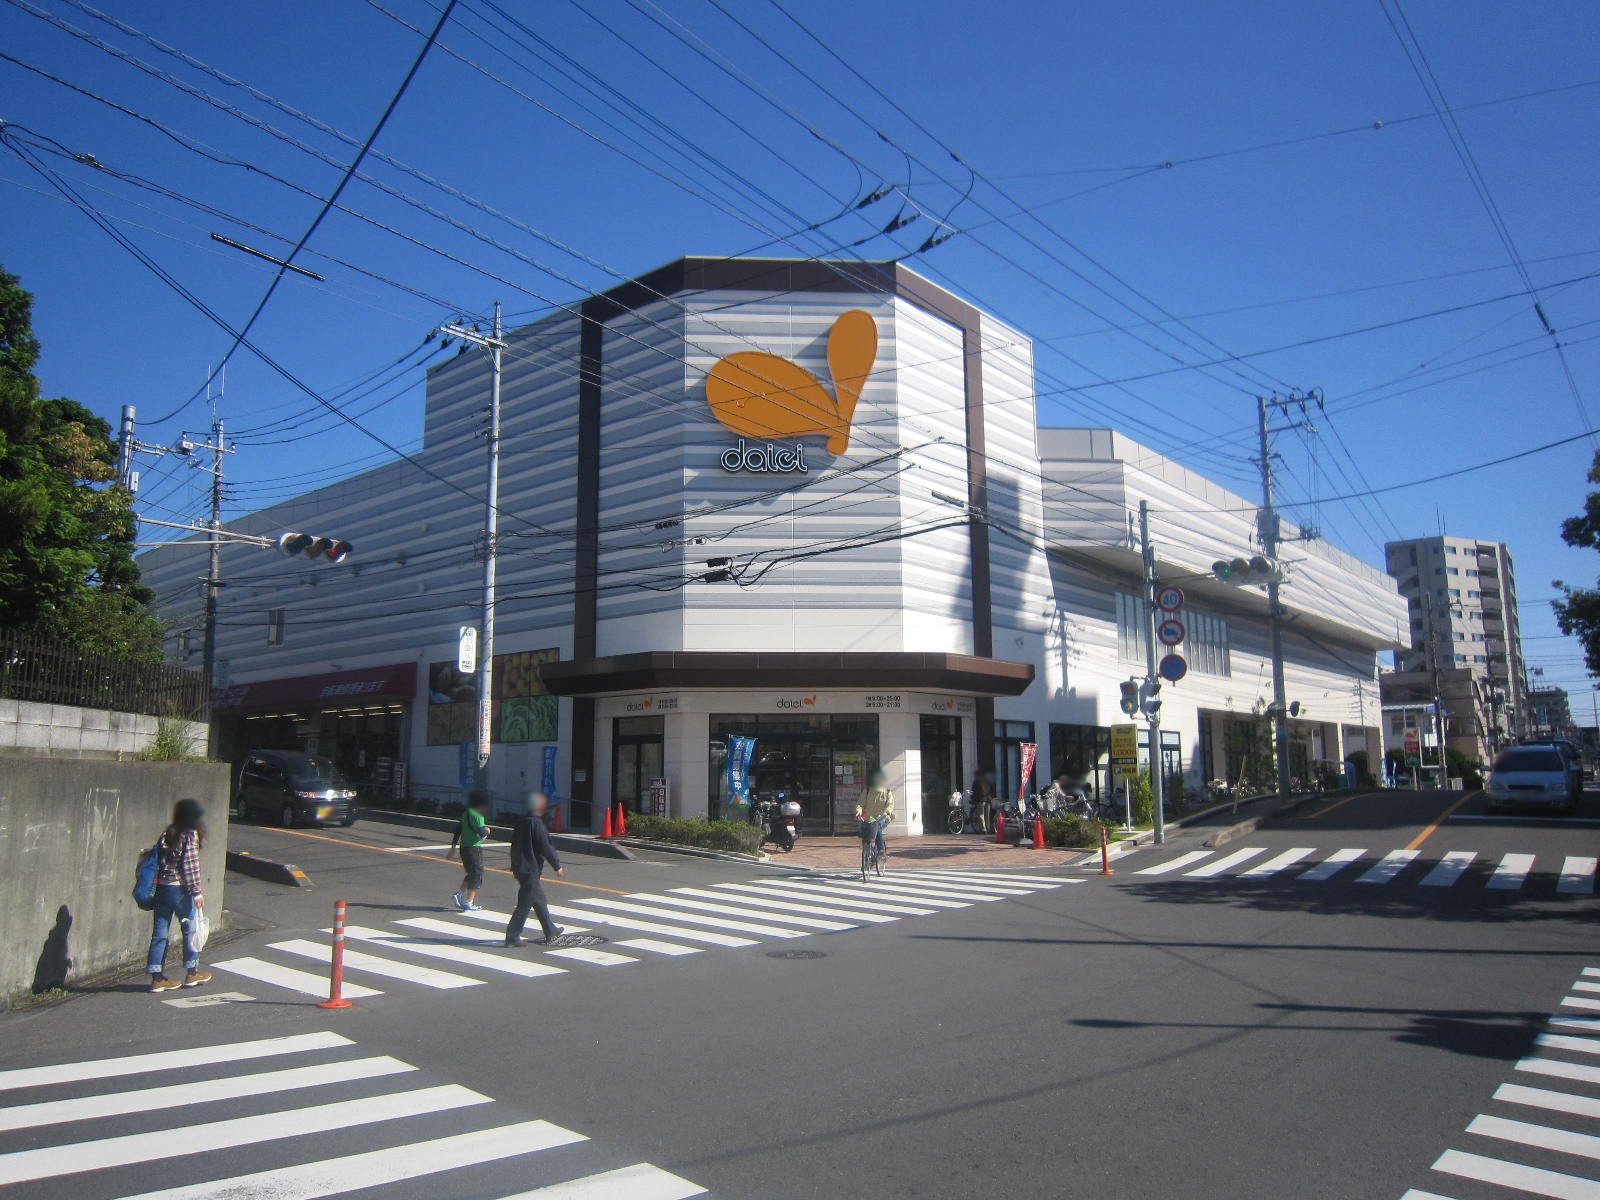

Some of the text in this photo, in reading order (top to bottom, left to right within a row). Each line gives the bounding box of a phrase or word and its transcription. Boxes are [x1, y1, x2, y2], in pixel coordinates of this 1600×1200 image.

[721, 439, 807, 472] daiei
[1163, 592, 1179, 606] 40
[776, 698, 802, 709] daiei
